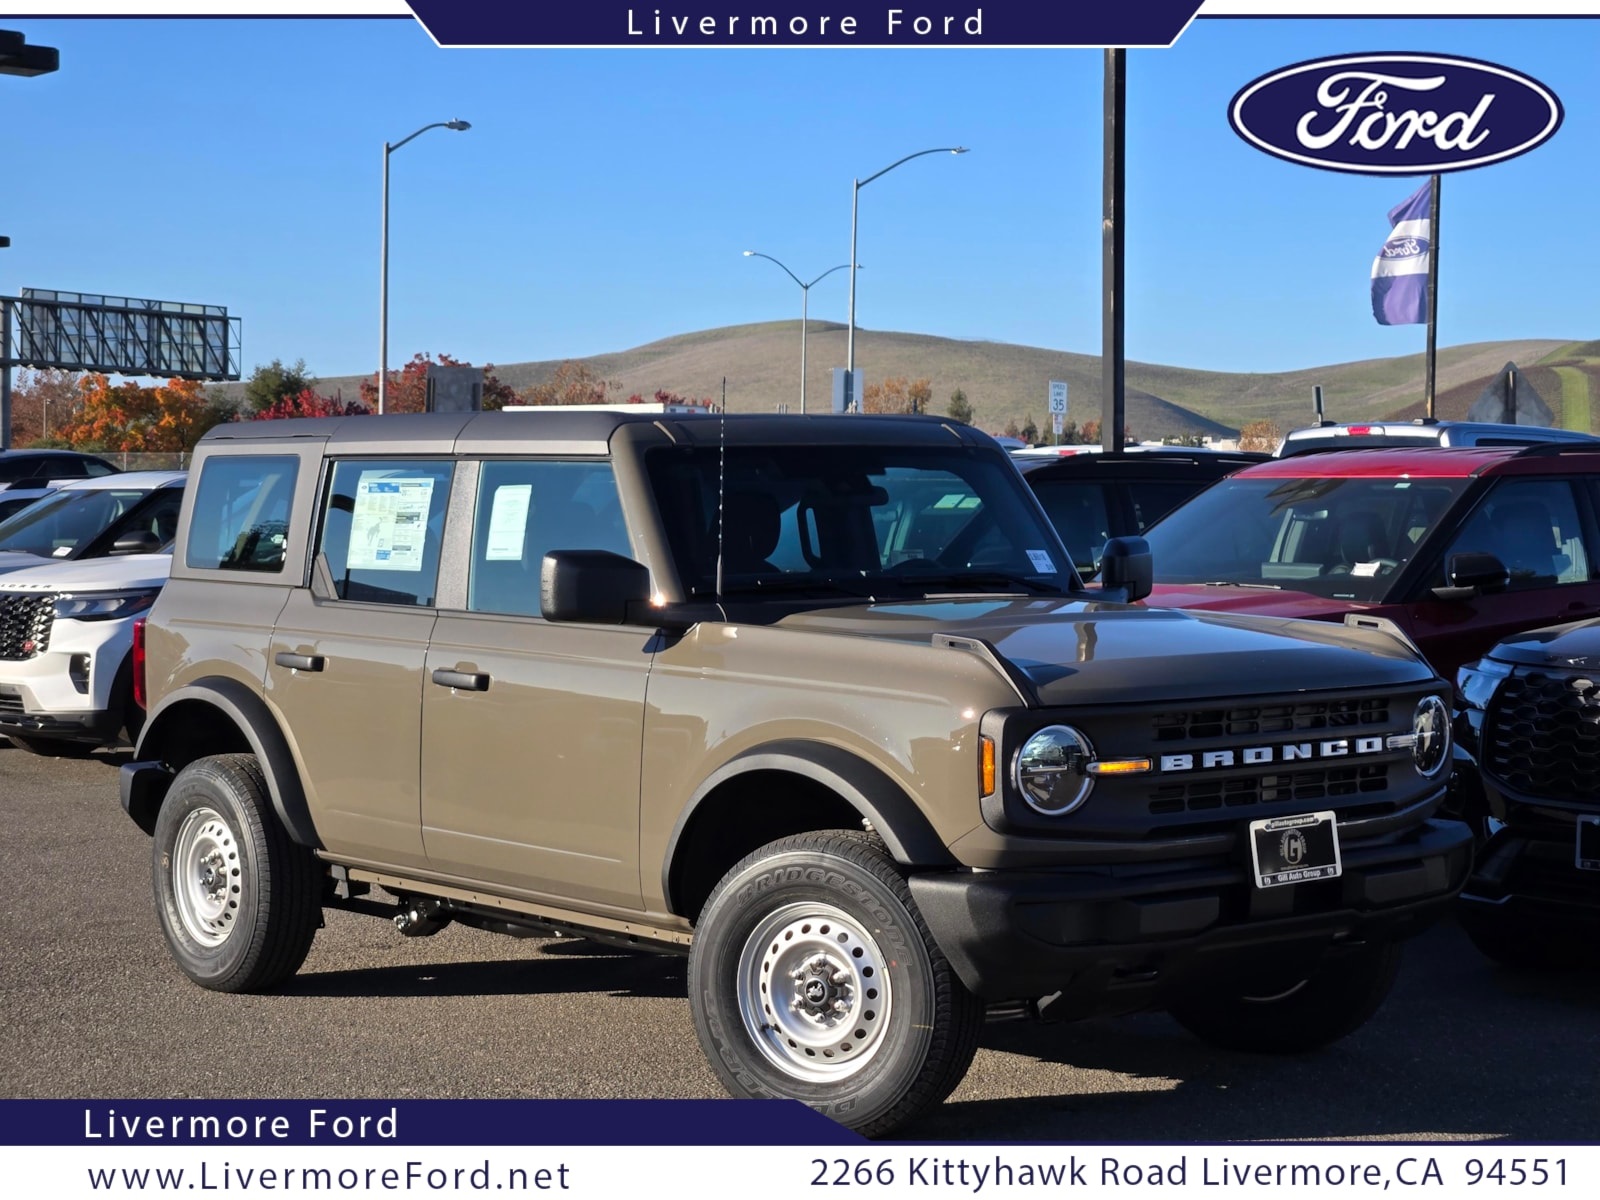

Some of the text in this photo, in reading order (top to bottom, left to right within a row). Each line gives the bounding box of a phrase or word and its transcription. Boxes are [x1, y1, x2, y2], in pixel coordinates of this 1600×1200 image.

[1053, 398, 1064, 411] 35
[1160, 737, 1383, 771] BRONCO
[1277, 869, 1321, 882] Gill Auto Group
[736, 866, 913, 967] BRIDGESTONE
